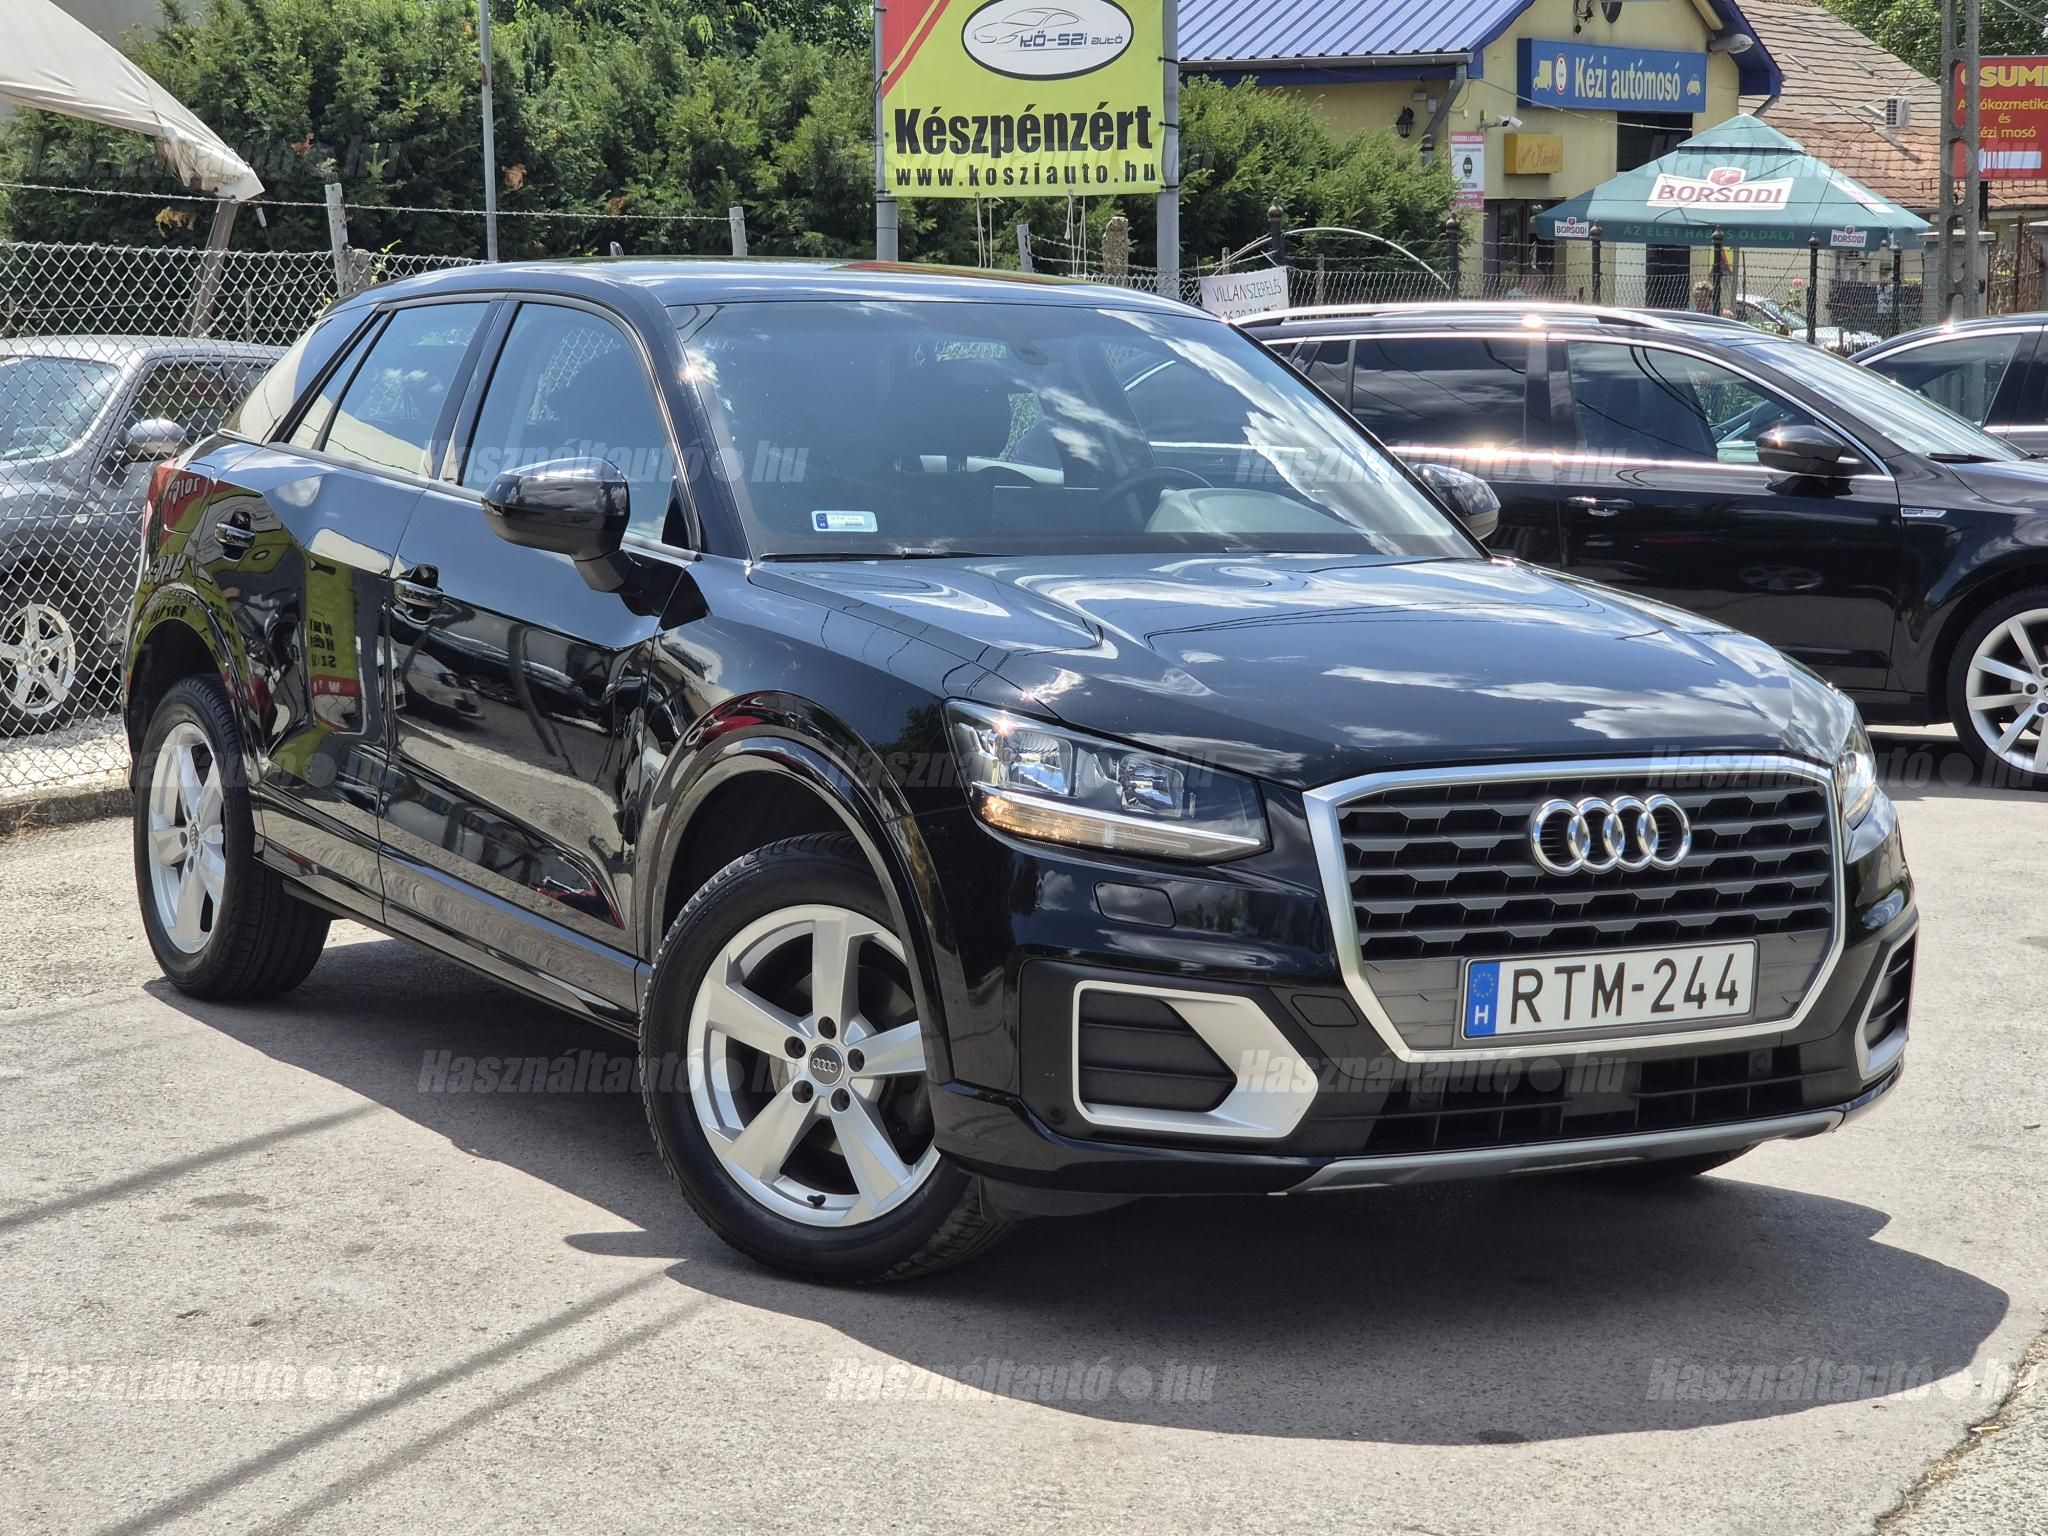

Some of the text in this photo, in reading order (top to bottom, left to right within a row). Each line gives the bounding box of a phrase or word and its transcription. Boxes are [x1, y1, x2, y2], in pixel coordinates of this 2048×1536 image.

[1575, 55, 1680, 102] Kézi autómosó
[1958, 98, 2048, 110] Aókozmetika
[1998, 113, 2012, 124] és
[894, 102, 1153, 158] Készpénzért
[1978, 126, 2036, 138] ézi mosó
[896, 160, 1156, 187] www.kosziauto.hu
[1656, 184, 1784, 204] BORSODI
[1556, 225, 1587, 235] BORSODI
[1684, 229, 1734, 240] HABS
[1738, 230, 1796, 241] OLDALA
[1832, 234, 1865, 244] BORSODI
[1510, 953, 1738, 1025] RTM-244
[1474, 1005, 1488, 1026] H
